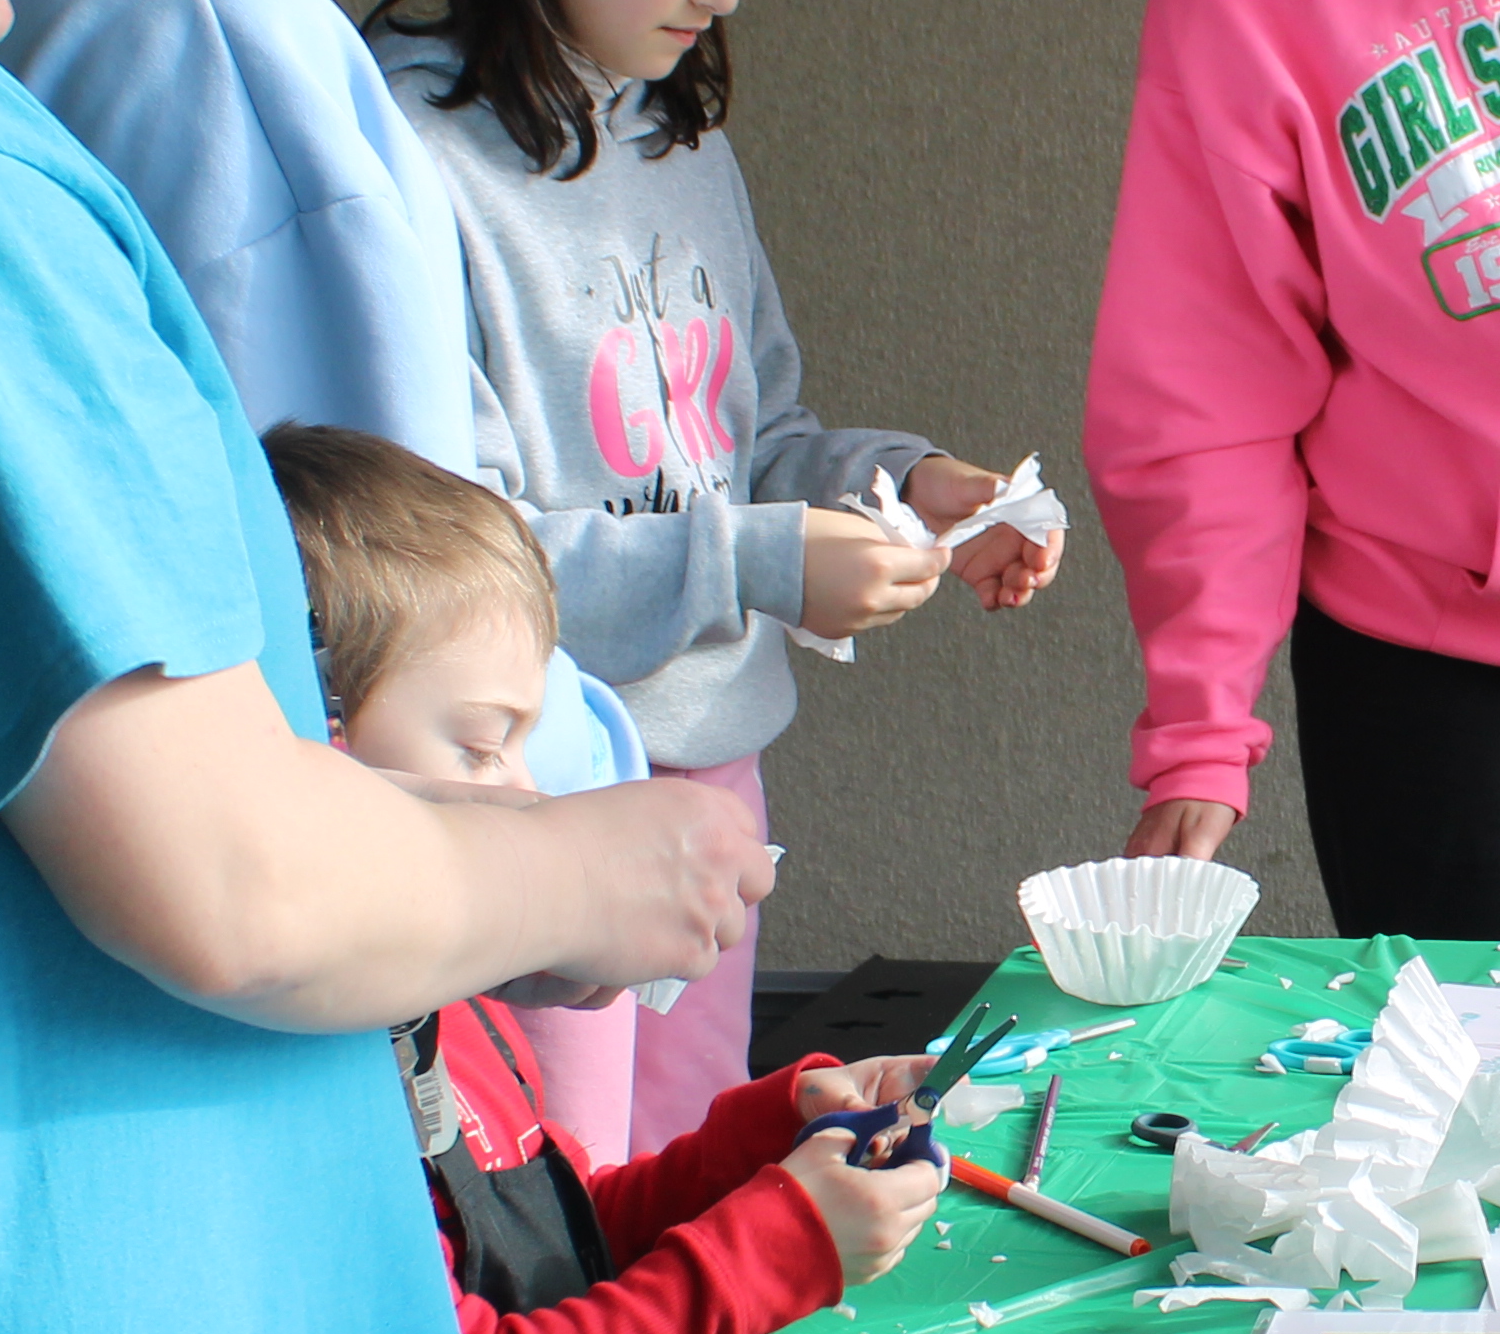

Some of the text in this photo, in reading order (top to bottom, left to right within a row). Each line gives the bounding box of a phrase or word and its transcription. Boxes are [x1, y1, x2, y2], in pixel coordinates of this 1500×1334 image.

[1336, 42, 1484, 223] GIRL
[693, 264, 716, 310] a
[589, 316, 735, 478] GRL
